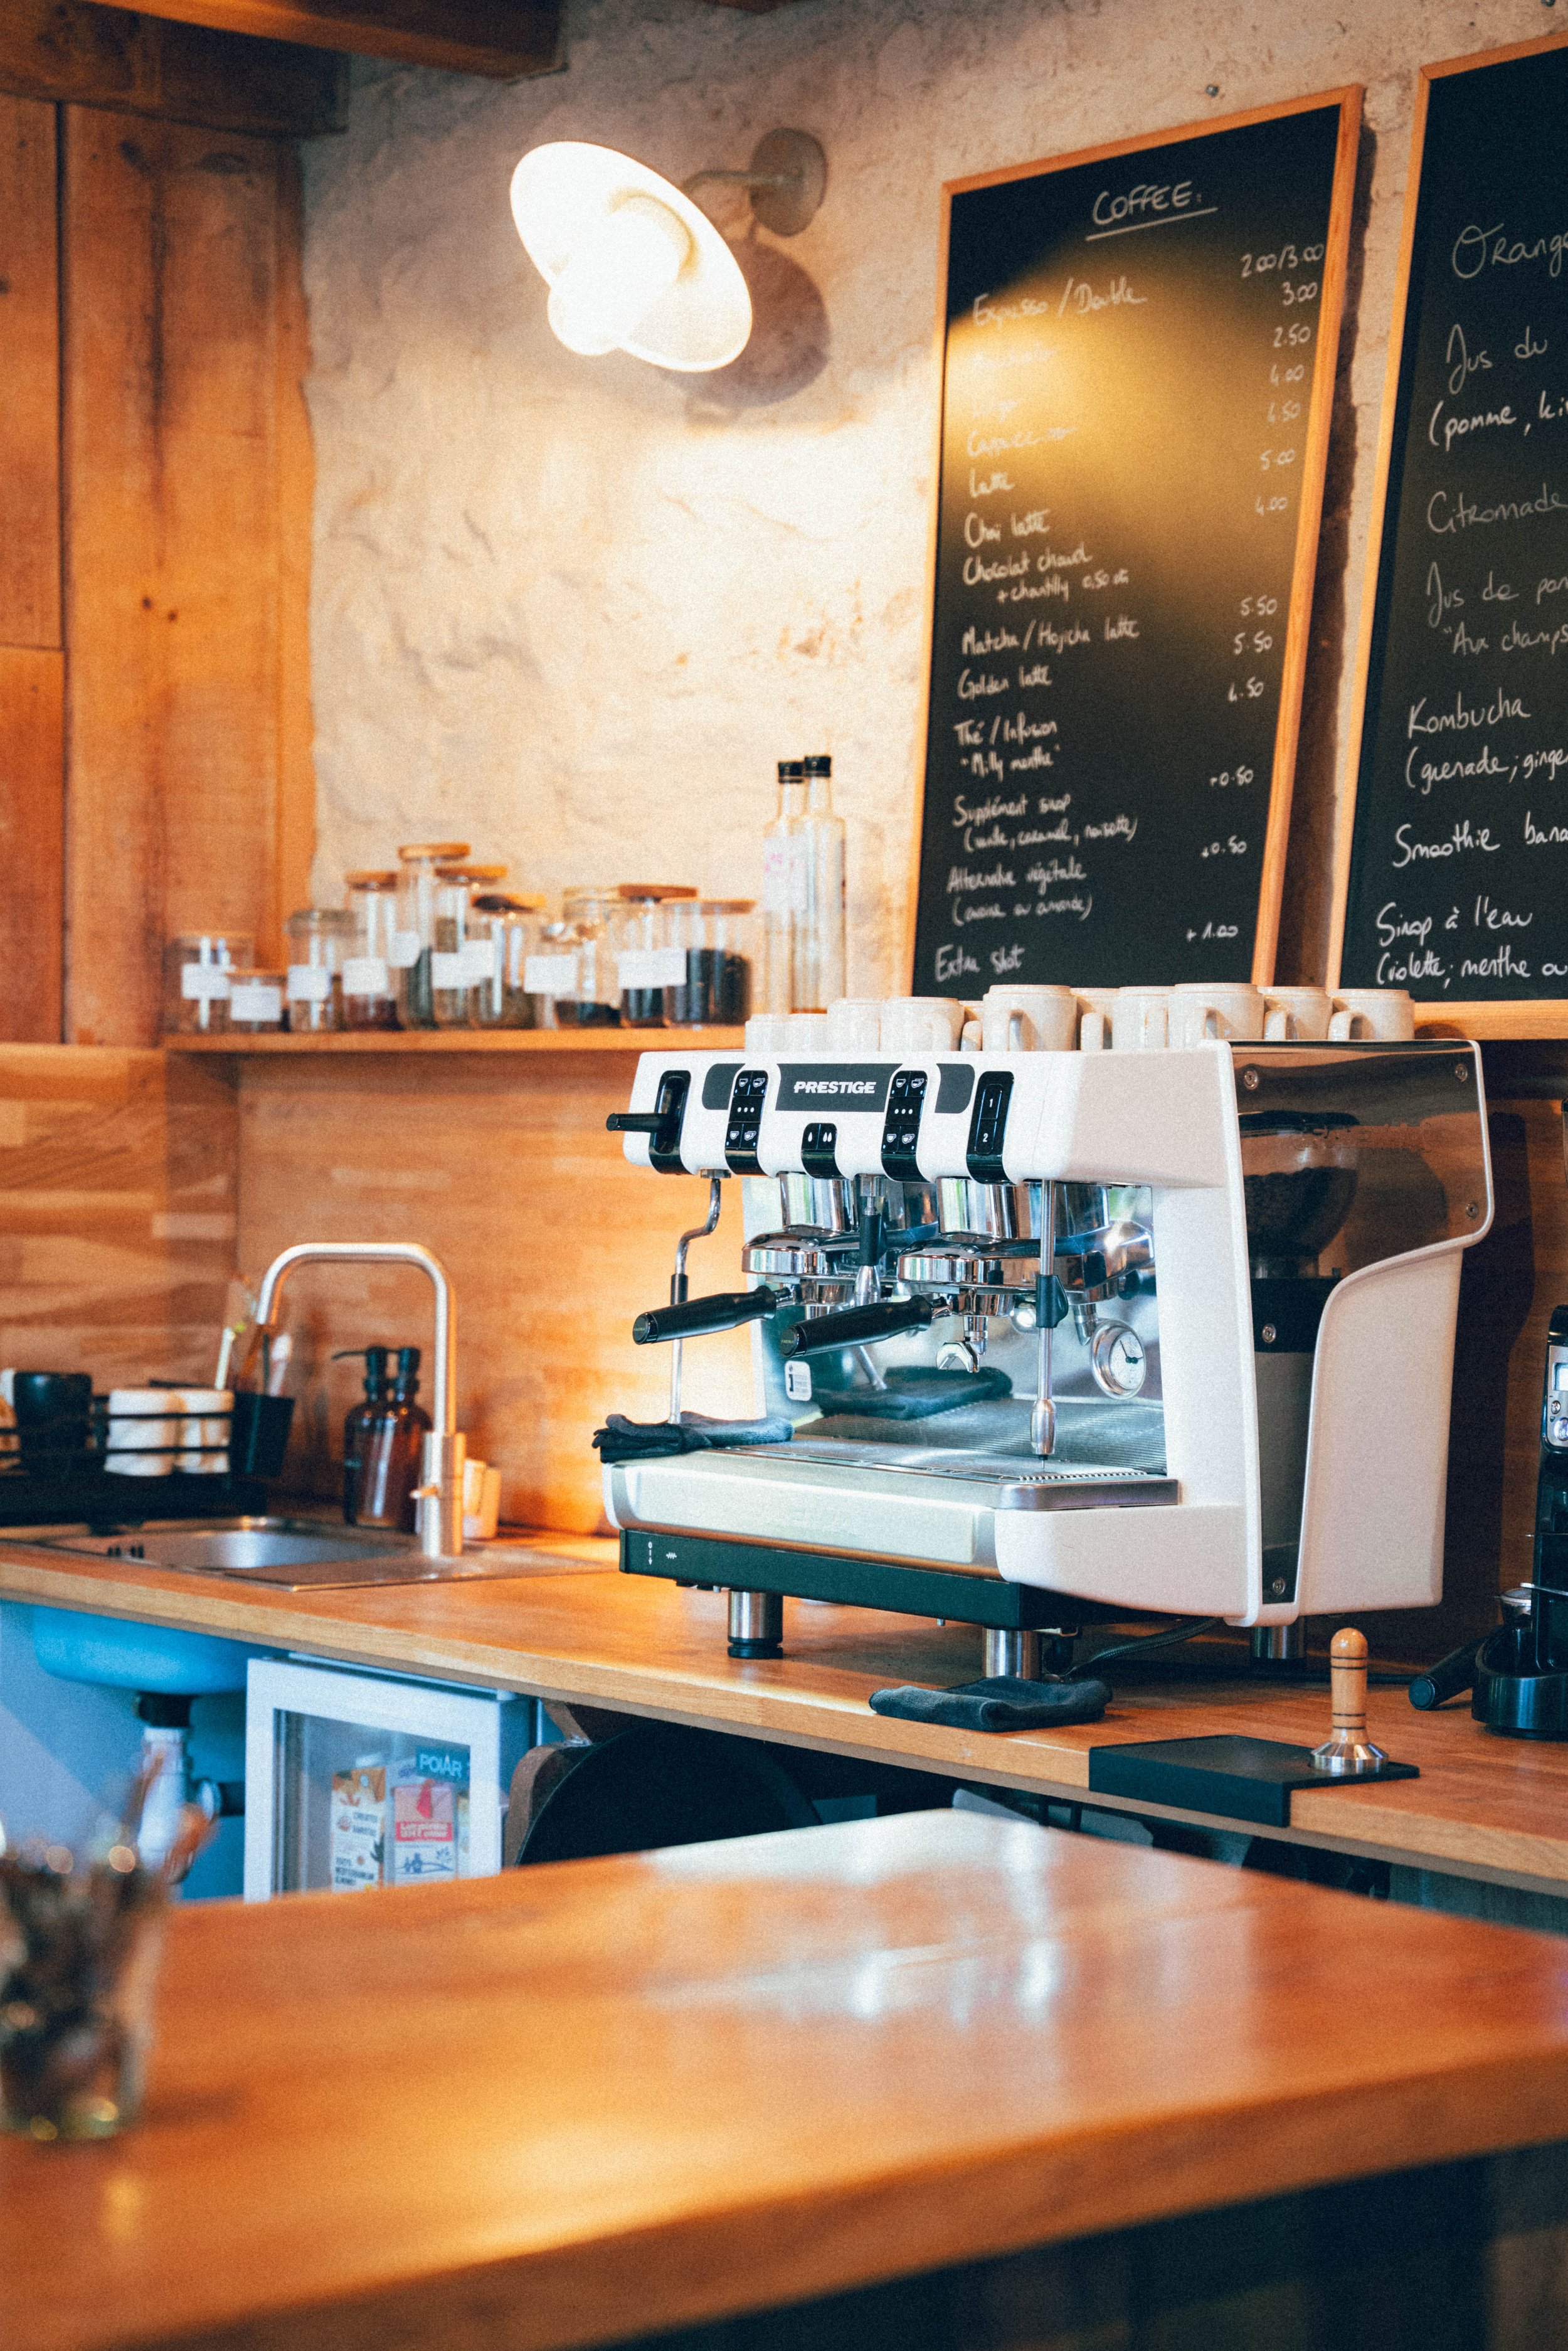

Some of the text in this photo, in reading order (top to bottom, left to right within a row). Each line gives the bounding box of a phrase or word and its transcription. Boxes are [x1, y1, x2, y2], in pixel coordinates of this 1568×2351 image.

[1274, 323, 1311, 348] 2.50
[1446, 324, 1548, 394] Jus du
[1539, 390, 1568, 420] ki
[1427, 482, 1568, 533] Citronnade
[963, 541, 1093, 585] Chocolat chaud
[1240, 595, 1278, 617] 5.50
[1426, 561, 1465, 627] Jus
[1482, 570, 1520, 601] de
[961, 625, 1020, 656] Matcha
[1104, 615, 1140, 642] latte
[1234, 630, 1273, 654] 5.50
[957, 665, 1052, 701] Golden latte
[1408, 687, 1532, 740] Kombucha
[1523, 748, 1568, 782] ginge
[1393, 820, 1501, 868] Smoothie
[1375, 894, 1533, 947] Sirop à l'eau
[935, 943, 1025, 982] Extra shot
[1461, 945, 1532, 979] menthe
[1542, 962, 1568, 977] ou
[793, 1081, 877, 1094] PRESTIGE
[989, 1098, 993, 1108] 1
[982, 1133, 988, 1142] 2
